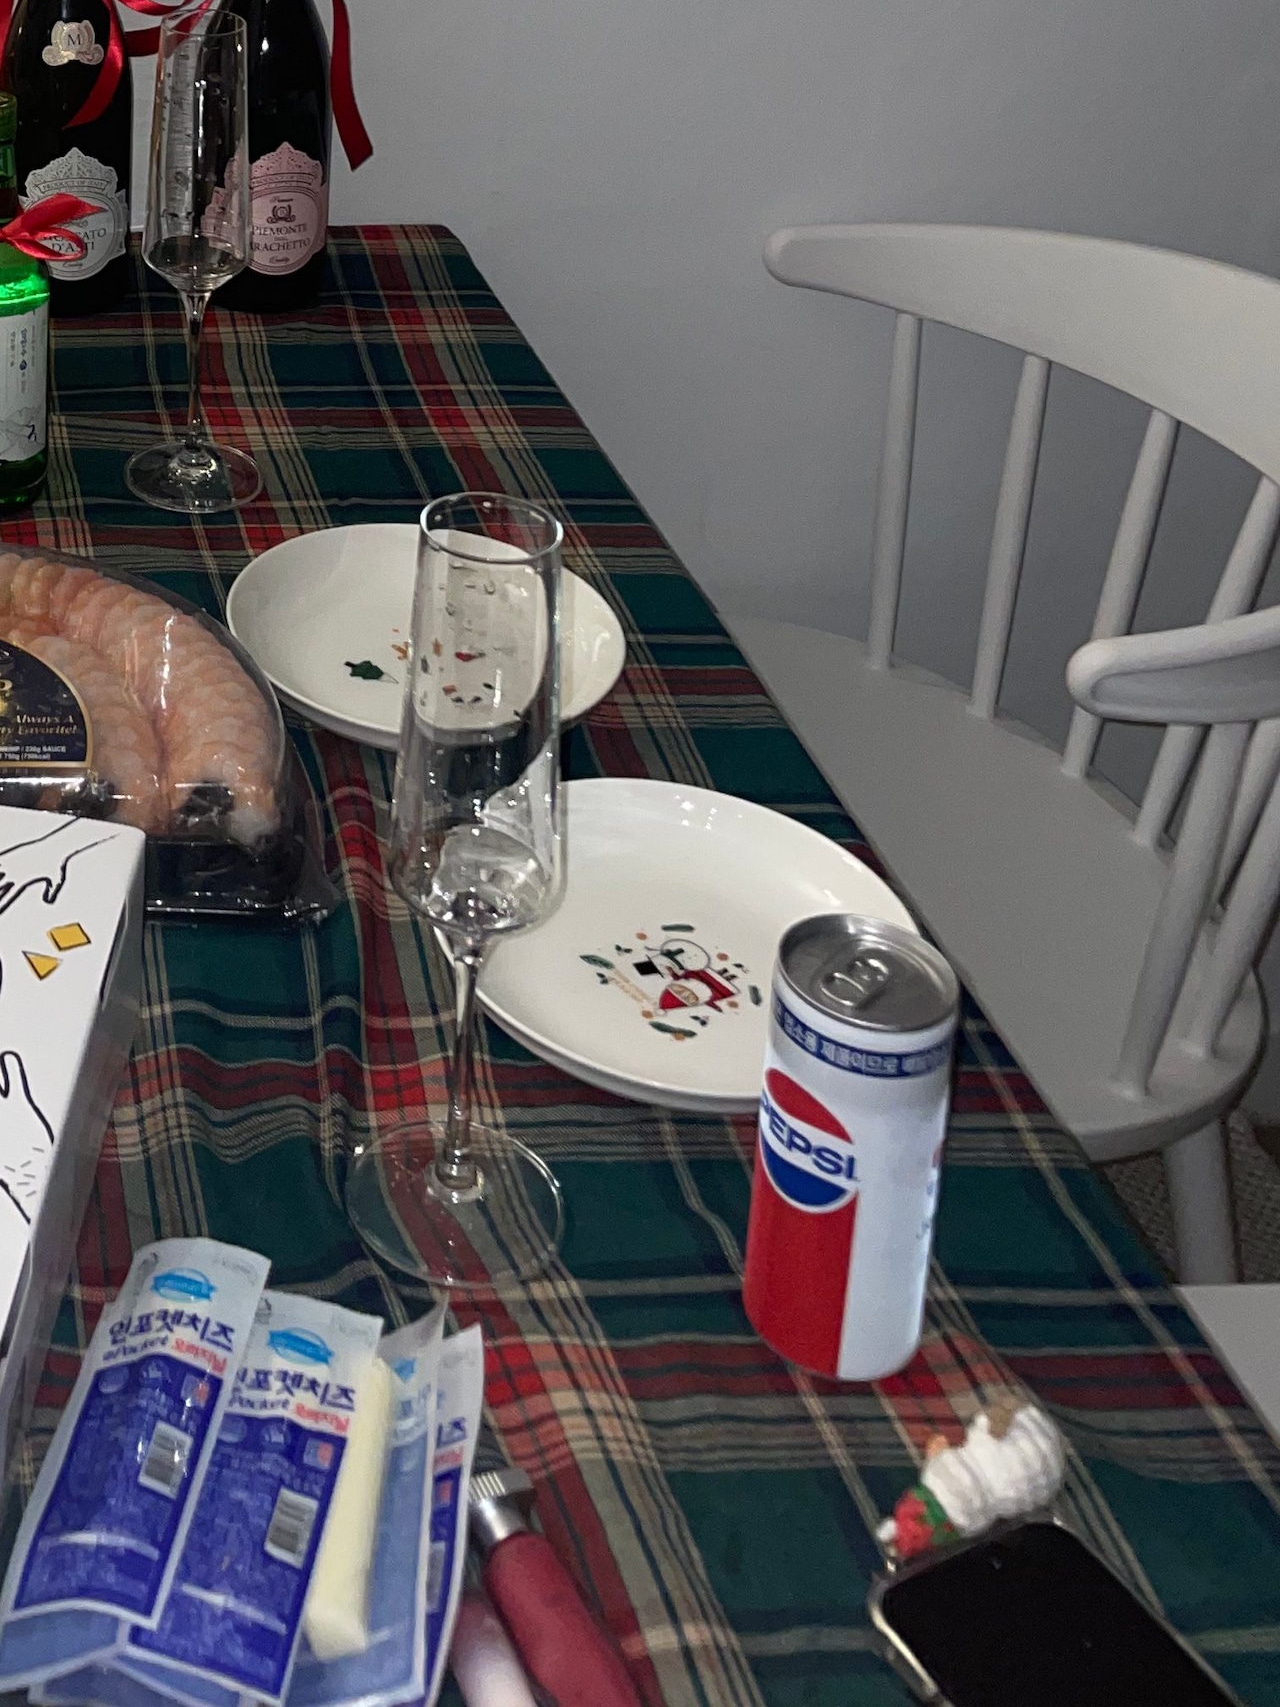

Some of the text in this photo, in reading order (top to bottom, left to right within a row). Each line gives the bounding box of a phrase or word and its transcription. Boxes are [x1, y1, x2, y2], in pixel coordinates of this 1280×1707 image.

[67, 33, 81, 46] M
[252, 222, 308, 236] PIEMONTE
[15, 714, 60, 725] Always
[18, 724, 78, 736] Favorite!
[761, 1088, 856, 1180] PEPSI
[109, 1308, 235, 1352] 인포켓치즈
